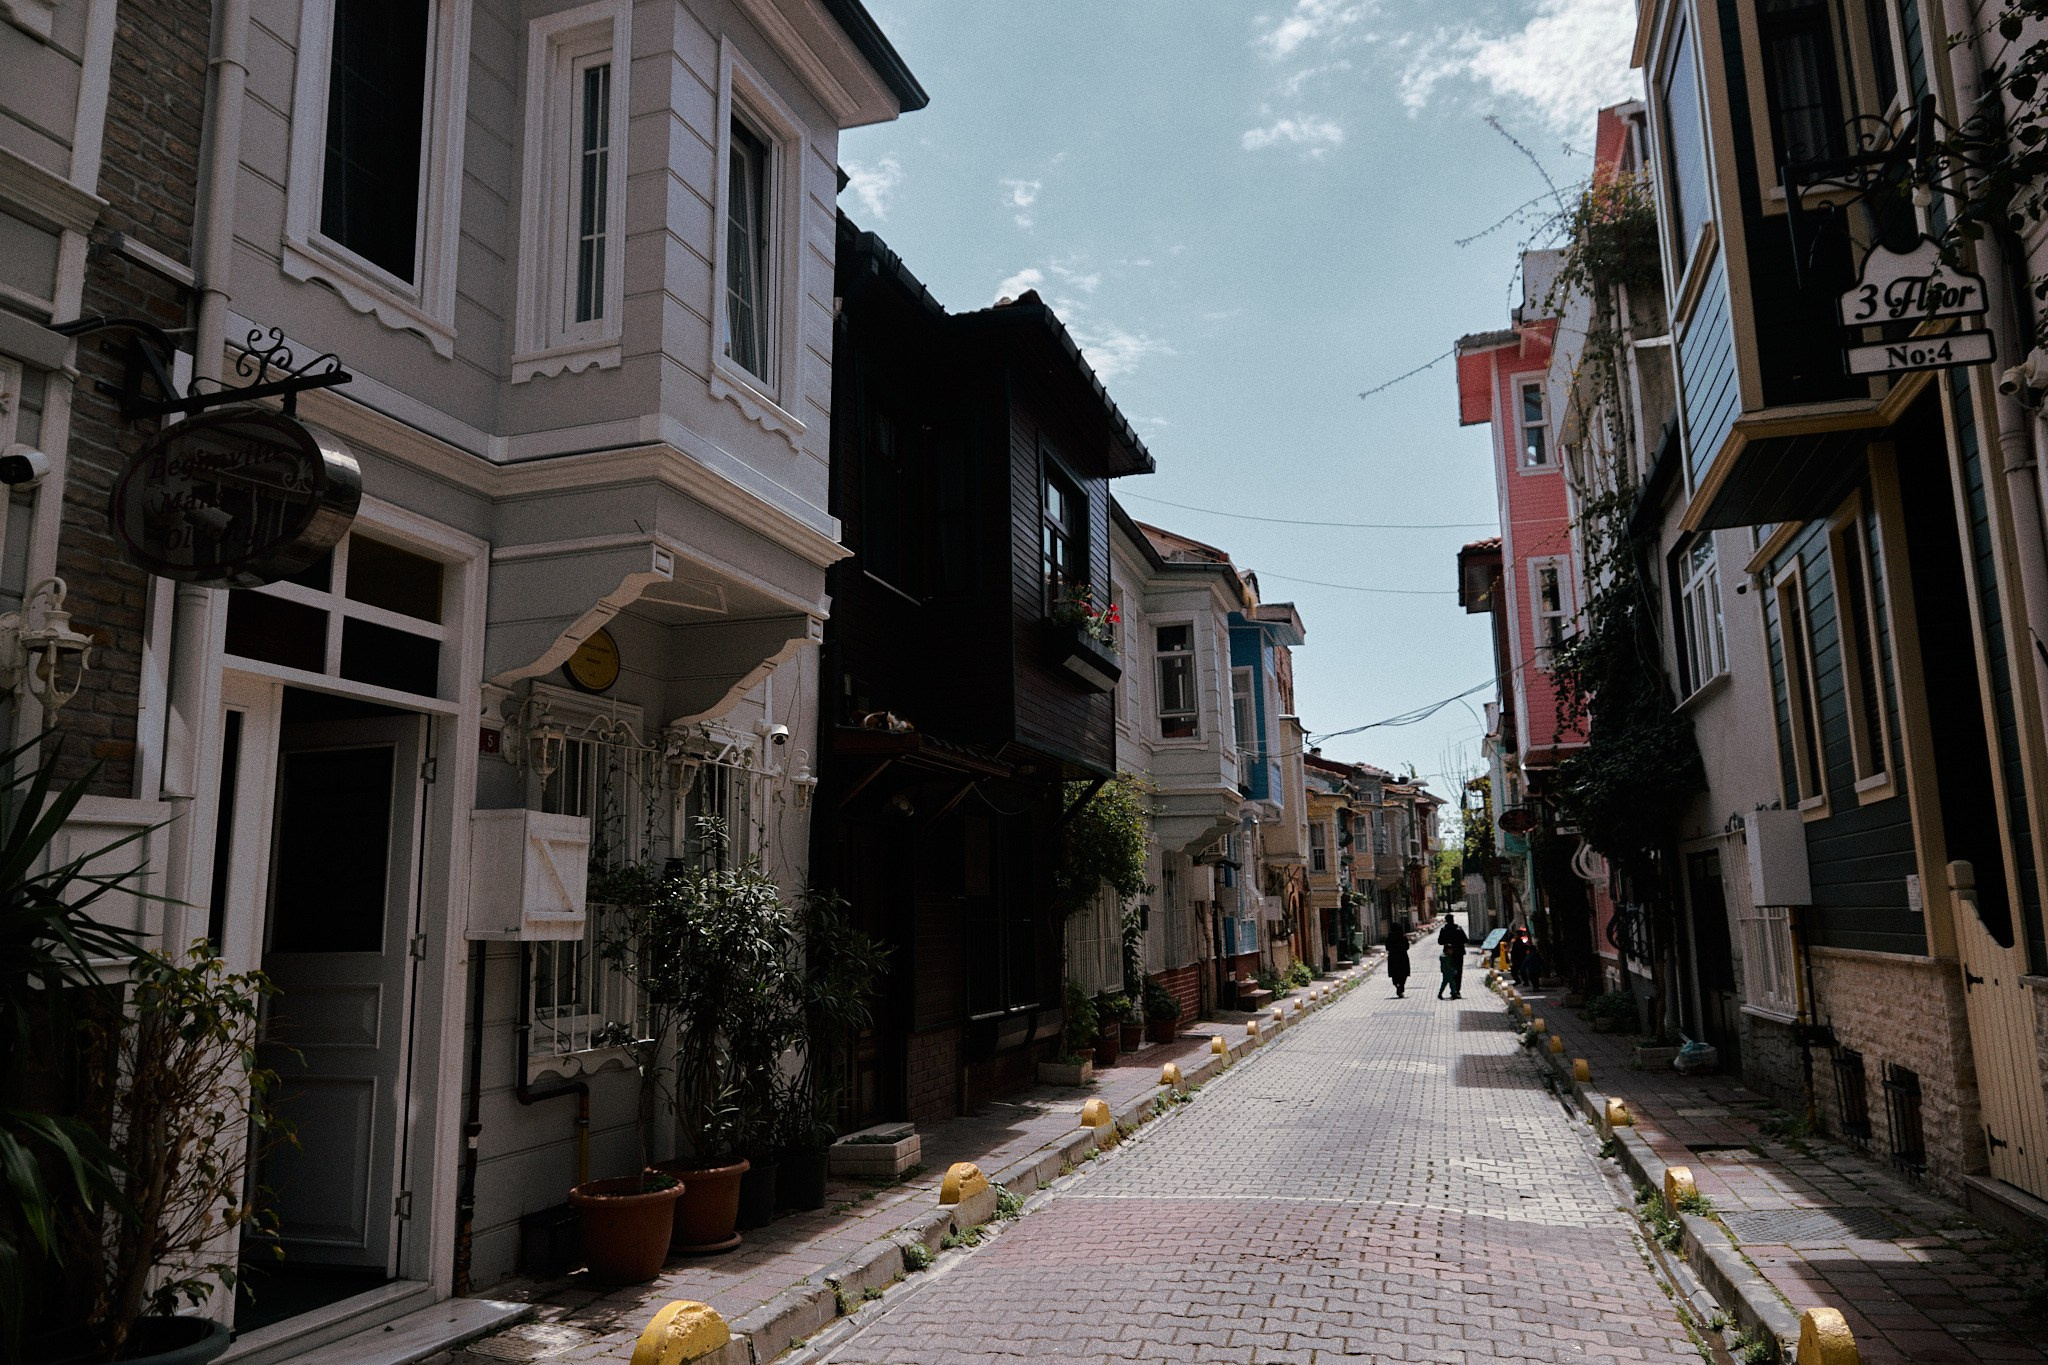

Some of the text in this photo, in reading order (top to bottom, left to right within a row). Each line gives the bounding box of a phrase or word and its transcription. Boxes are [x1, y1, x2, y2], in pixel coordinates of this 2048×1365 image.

[1855, 285, 1878, 319] 3
[1886, 341, 1953, 368] No:4
[487, 734, 494, 748] 5
